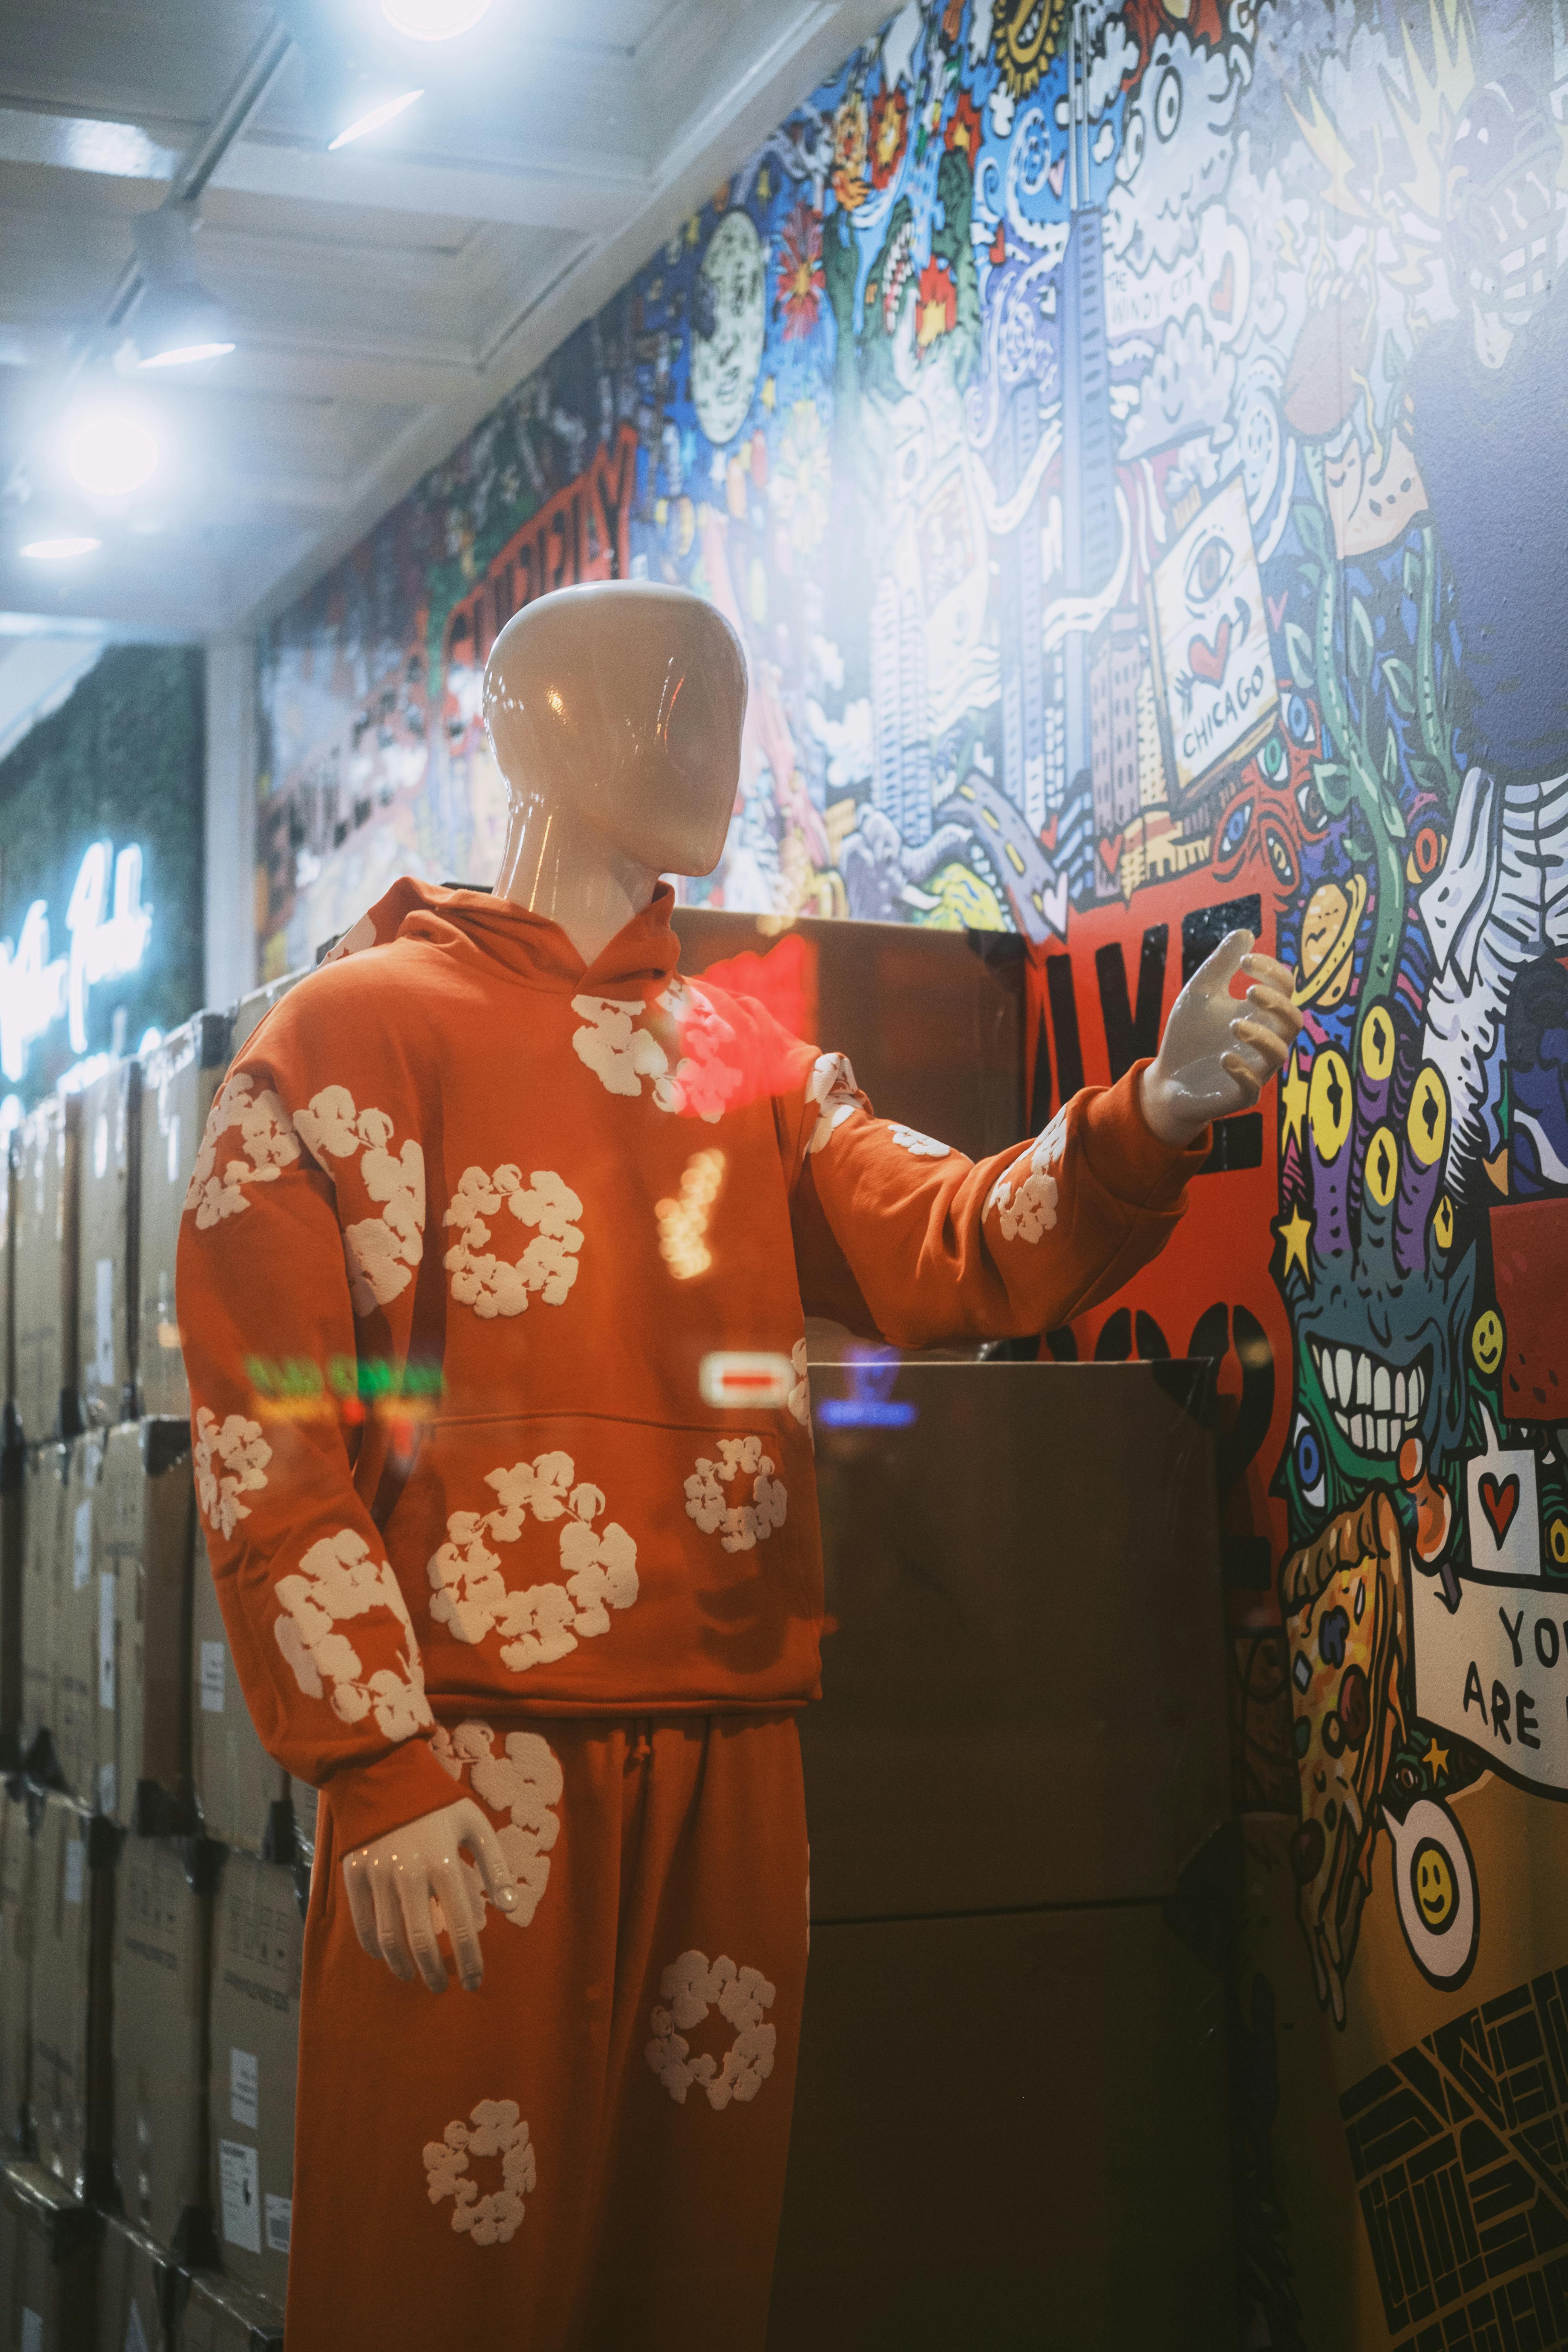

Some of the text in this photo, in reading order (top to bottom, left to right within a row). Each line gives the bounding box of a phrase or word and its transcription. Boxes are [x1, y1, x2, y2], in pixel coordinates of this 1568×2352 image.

[1111, 286, 1163, 325] WINDY
[1183, 665, 1263, 759] CHICAGO
[1499, 1606, 1568, 1669] YO
[1463, 1660, 1541, 1750] ARE
